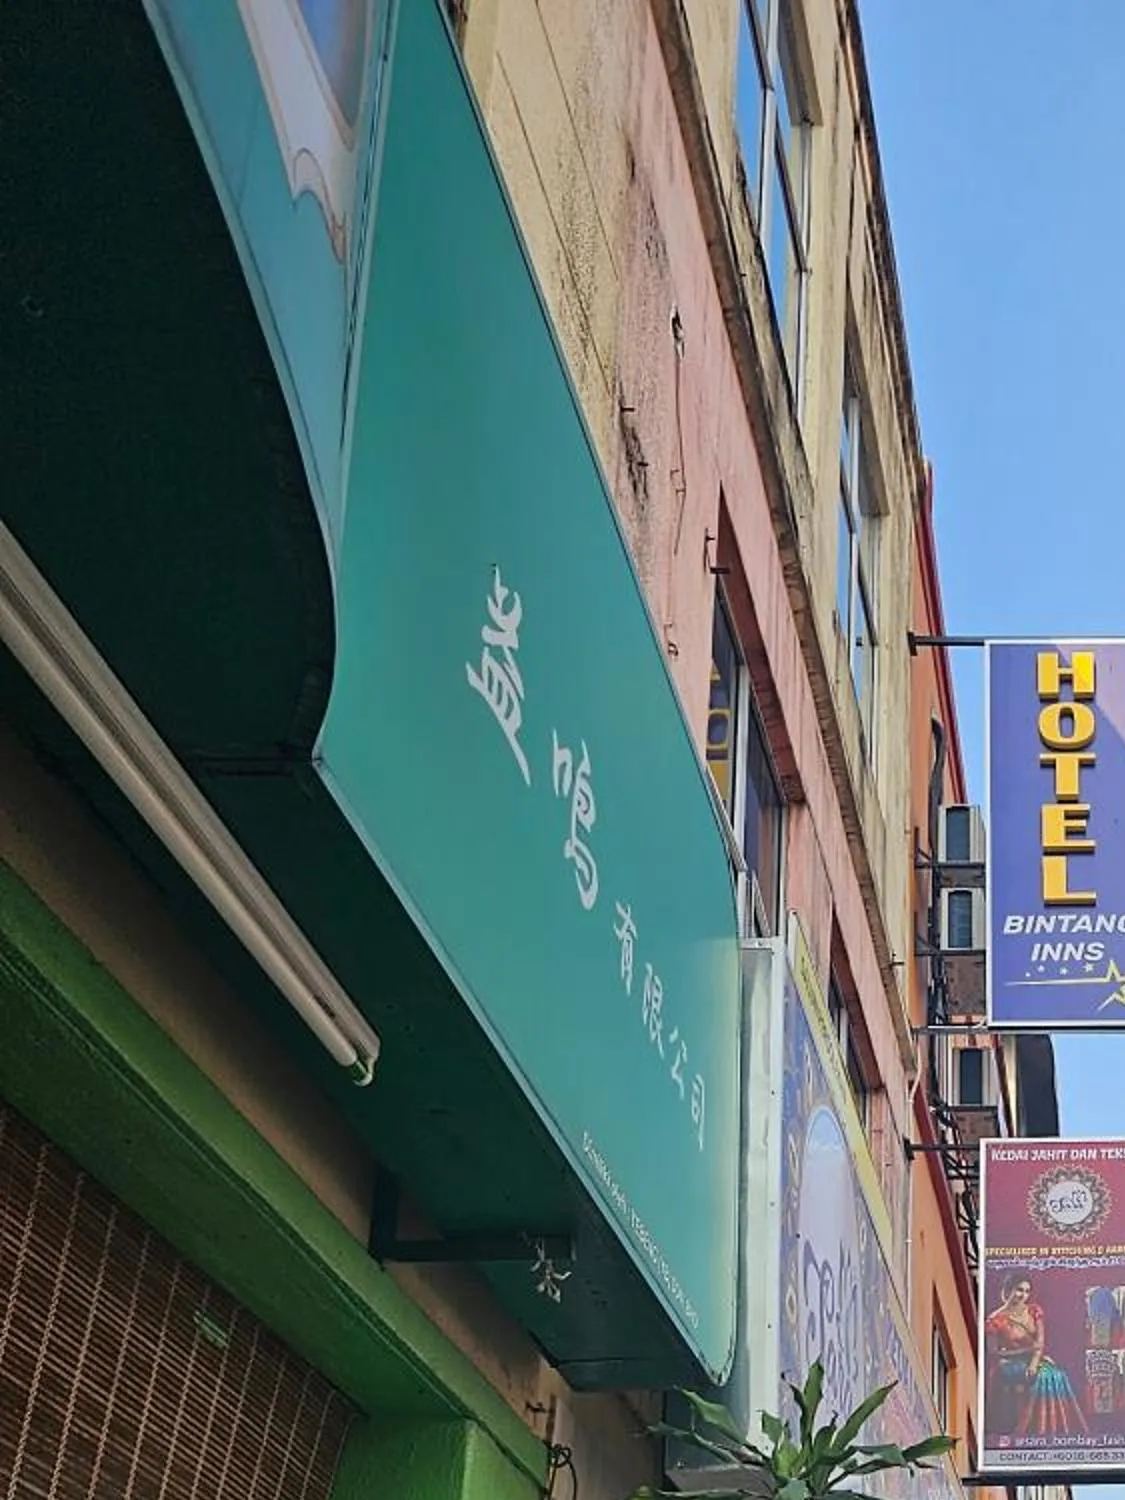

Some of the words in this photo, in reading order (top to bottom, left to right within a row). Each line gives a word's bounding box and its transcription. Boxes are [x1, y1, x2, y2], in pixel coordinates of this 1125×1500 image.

[1036, 651, 1097, 904] HOTEL
[1031, 943, 1105, 962] INNS
[991, 1149, 1028, 1161] KEDAI
[1032, 1149, 1068, 1161] JAHIT
[1071, 1148, 1096, 1160] DAN
